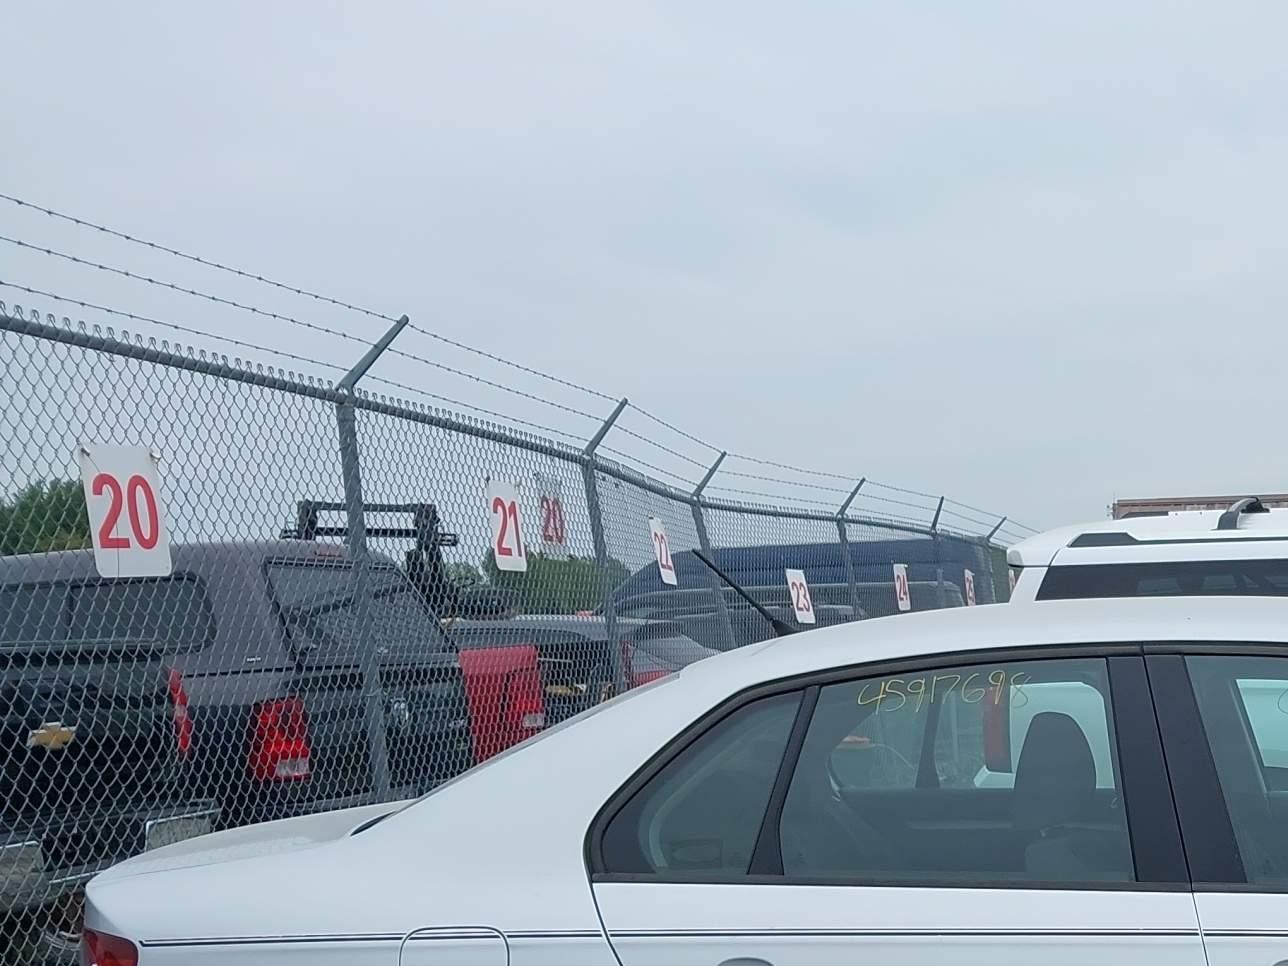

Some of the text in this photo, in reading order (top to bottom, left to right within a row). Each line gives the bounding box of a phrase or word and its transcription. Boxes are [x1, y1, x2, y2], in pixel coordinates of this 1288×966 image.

[92, 473, 159, 550] 20
[492, 497, 523, 558] 21
[654, 532, 673, 572] 22
[791, 581, 811, 612] 23
[896, 575, 909, 601] 24
[858, 670, 1032, 715] 45917698
